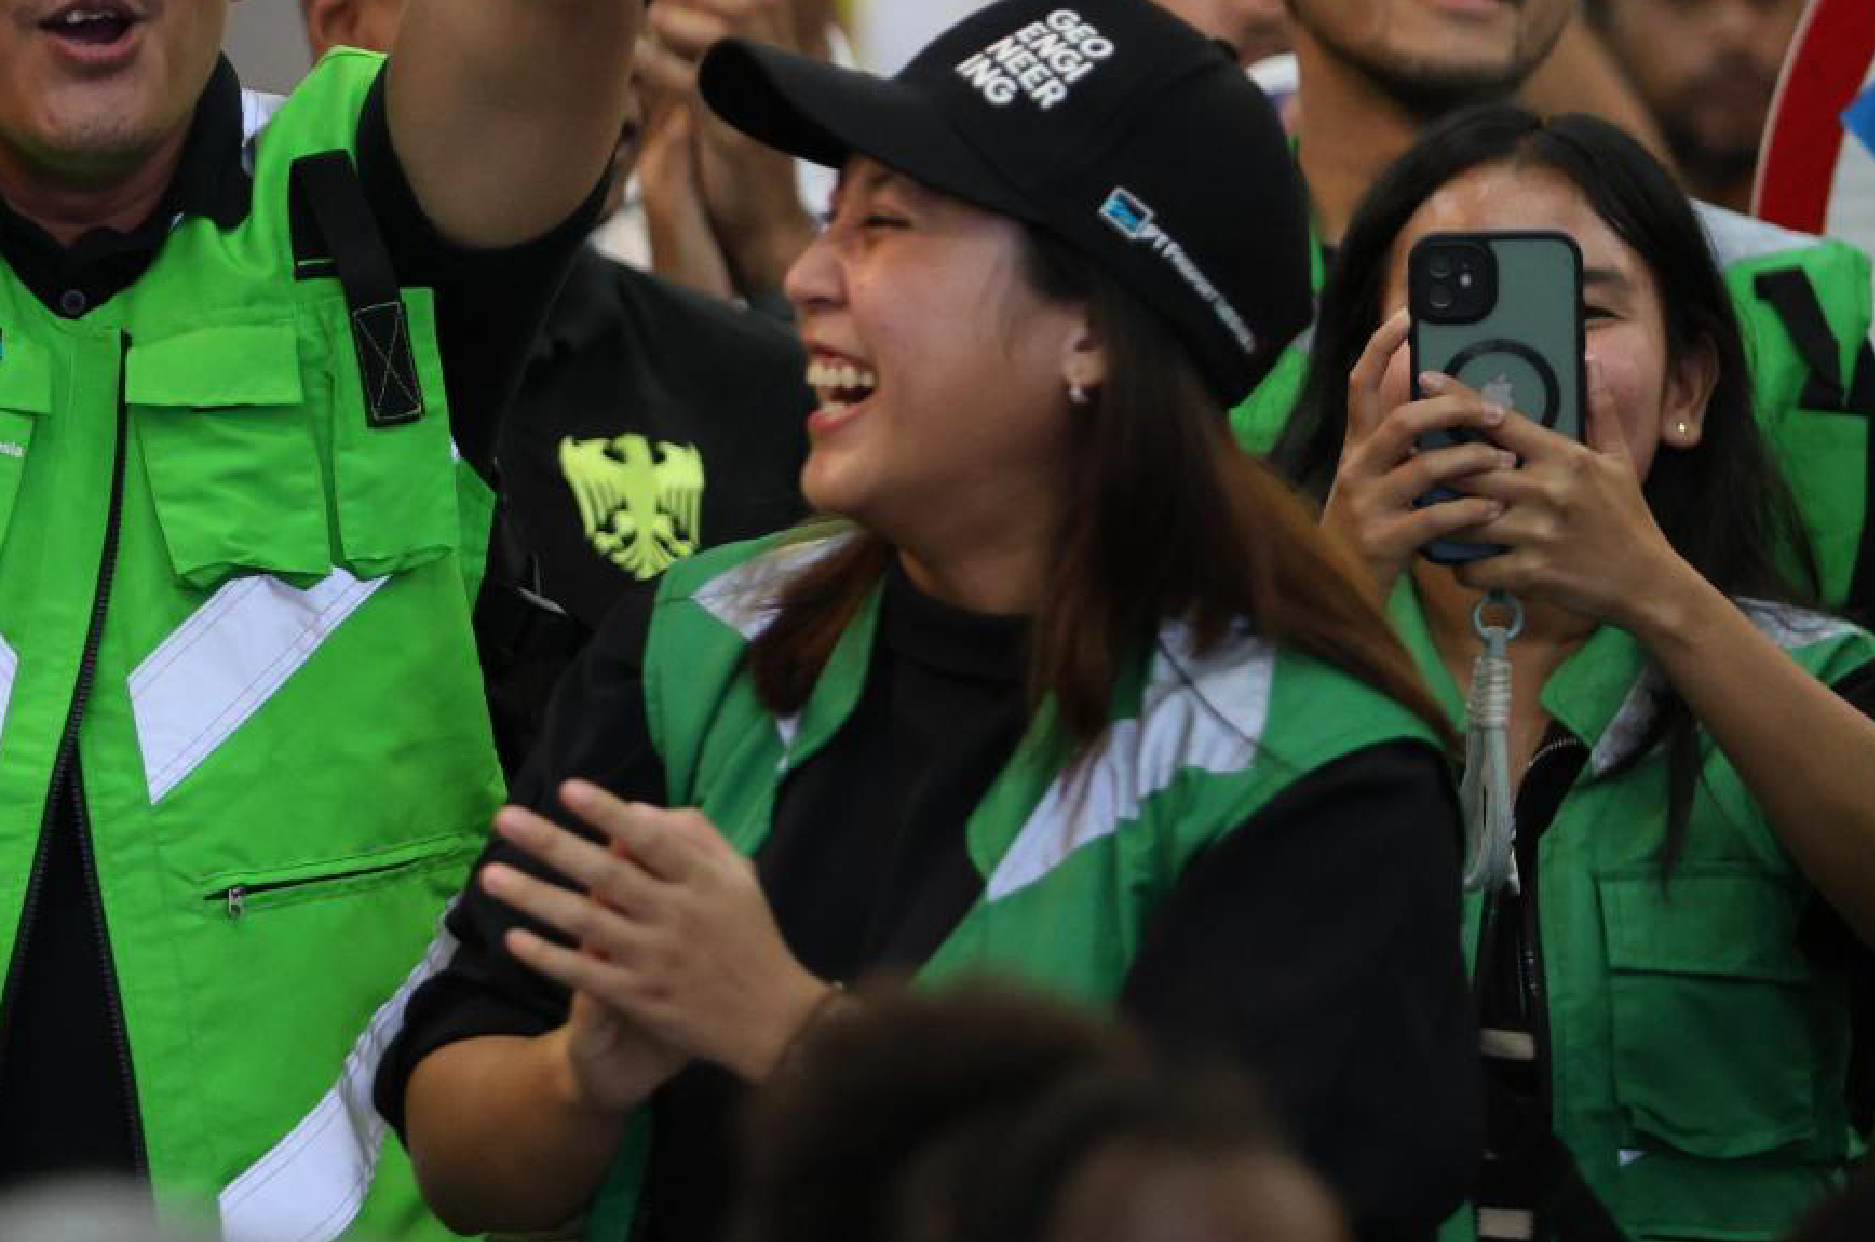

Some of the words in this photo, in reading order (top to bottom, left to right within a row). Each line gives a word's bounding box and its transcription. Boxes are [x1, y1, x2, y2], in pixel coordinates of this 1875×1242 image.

[1013, 20, 1095, 85] ENGI
[1045, 8, 1116, 60] GEO
[953, 51, 1019, 105] ING
[983, 34, 1069, 111] NEER
